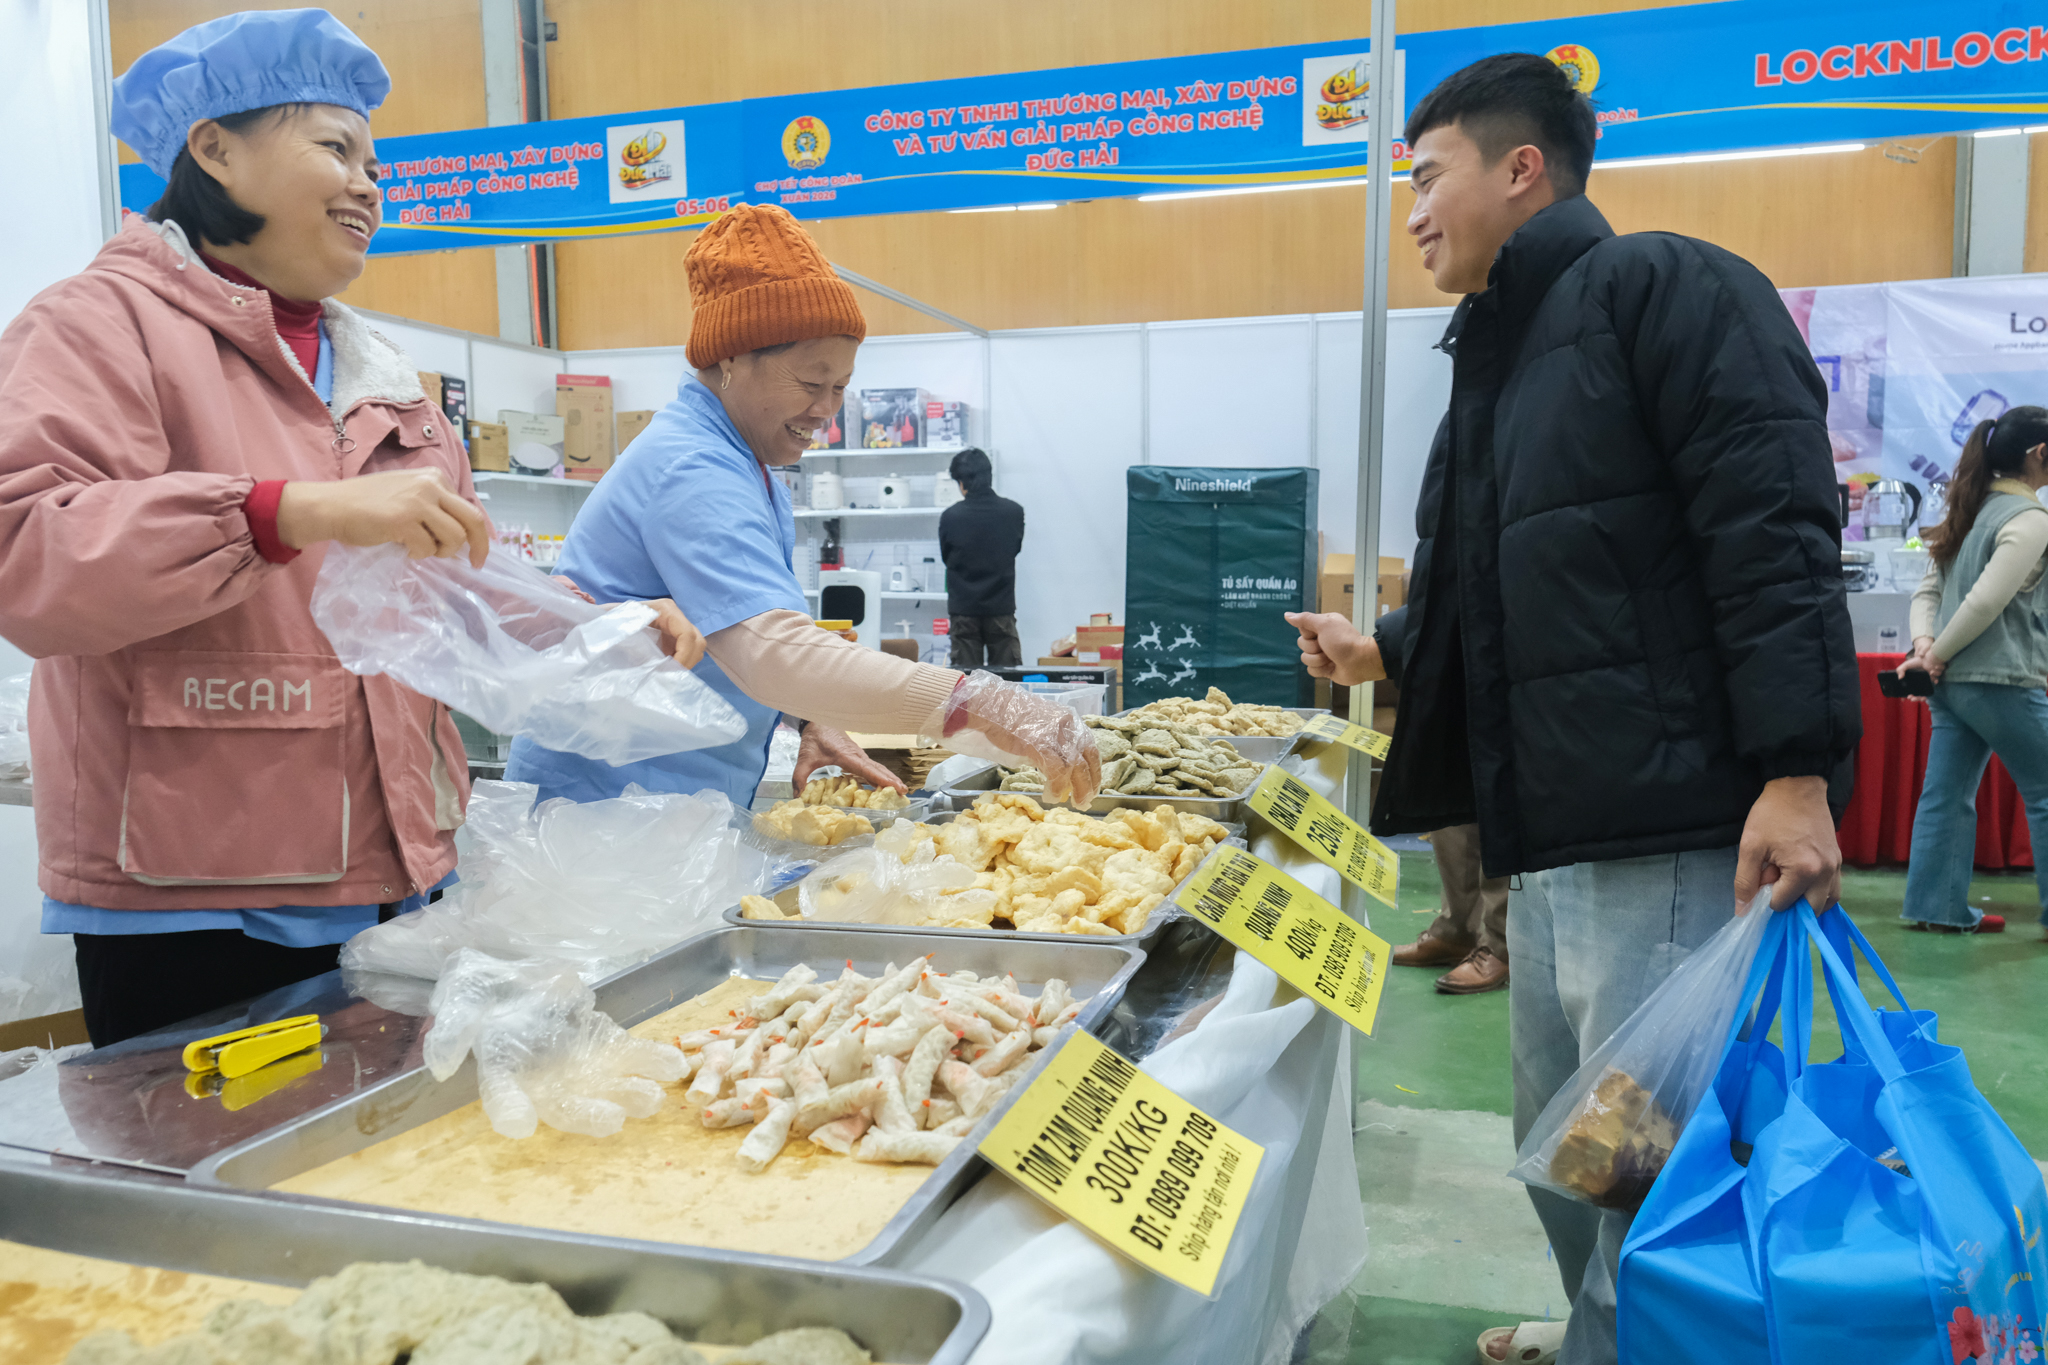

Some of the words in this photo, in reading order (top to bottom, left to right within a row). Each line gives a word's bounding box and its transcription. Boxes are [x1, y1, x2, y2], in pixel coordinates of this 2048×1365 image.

[1755, 25, 2048, 88] LOCKNLOCK
[865, 109, 925, 132] CÔNG
[928, 108, 955, 127] TY
[959, 102, 1018, 124] TNHH
[1023, 92, 1116, 118] THƯƠNG
[1121, 87, 1171, 112] MẠI,
[1175, 80, 1221, 105] XÂY
[1227, 76, 1297, 102] DỰNG
[893, 134, 926, 156] VÀ
[928, 133, 956, 152] TƯ
[961, 125, 1006, 150] VẤN
[1011, 121, 1057, 146] GIẢI
[1061, 116, 1123, 143] PHÁP
[1128, 112, 1193, 137] CÔNG
[1199, 104, 1264, 131] NGHỆ
[394, 154, 466, 179] THƯƠNG
[470, 151, 509, 177] MẠI,
[511, 145, 549, 168] XÂY
[552, 142, 603, 167] DỰNG
[1026, 147, 1074, 172] ĐỨC
[1078, 141, 1119, 167] HẢI
[387, 179, 422, 202] GIẢI
[425, 176, 473, 200] PHÁP
[476, 169, 525, 194] CÔNG
[529, 166, 579, 190] NGHỆ
[755, 179, 778, 193] CHỢ
[779, 176, 798, 190] TẾT
[799, 175, 829, 188] CÔNG
[830, 172, 862, 186] ĐOÀN
[780, 190, 810, 204] XUÂN
[811, 189, 837, 201] 2026
[399, 203, 437, 224] ĐỨC
[440, 199, 471, 220] HẢI
[675, 197, 730, 218] 05-06
[1236, 574, 1254, 588] SẤY
[1284, 577, 1298, 590] ÁO
[184, 677, 312, 712] RECAM
[1273, 787, 1305, 814] CÁ
[1281, 777, 1310, 804] THU
[1262, 794, 1300, 831] CHẢ
[1306, 812, 1350, 858] 250k/kg
[1220, 863, 1250, 886] GIÃ
[1229, 853, 1259, 874] TAY
[1191, 888, 1229, 923] CHẢ
[1207, 877, 1243, 905] MỰC
[1261, 881, 1293, 911] NINH
[1241, 901, 1282, 941] QUẢNG
[1334, 922, 1356, 947] 9709
[1284, 918, 1327, 960] 400k/kg
[1329, 939, 1351, 963] 909
[1322, 955, 1346, 980] 098
[1351, 971, 1373, 994] hàng
[1314, 973, 1340, 999] ĐT:
[1345, 991, 1367, 1013] Ship
[1088, 1049, 1137, 1095] NINH
[1056, 1076, 1119, 1134] QUẢNG
[1038, 1114, 1092, 1165] ZAM
[1180, 1112, 1217, 1149] 709
[1085, 1099, 1168, 1205] 300K/KG
[1166, 1140, 1204, 1179] 099
[1219, 1149, 1239, 1174] nhà
[1013, 1143, 1072, 1194] TÔM
[1145, 1169, 1190, 1220] 0989
[1203, 1187, 1227, 1207] tận
[1128, 1213, 1172, 1252] ĐT:
[1190, 1204, 1222, 1236] hàng
[1179, 1233, 1210, 1262] Ship
